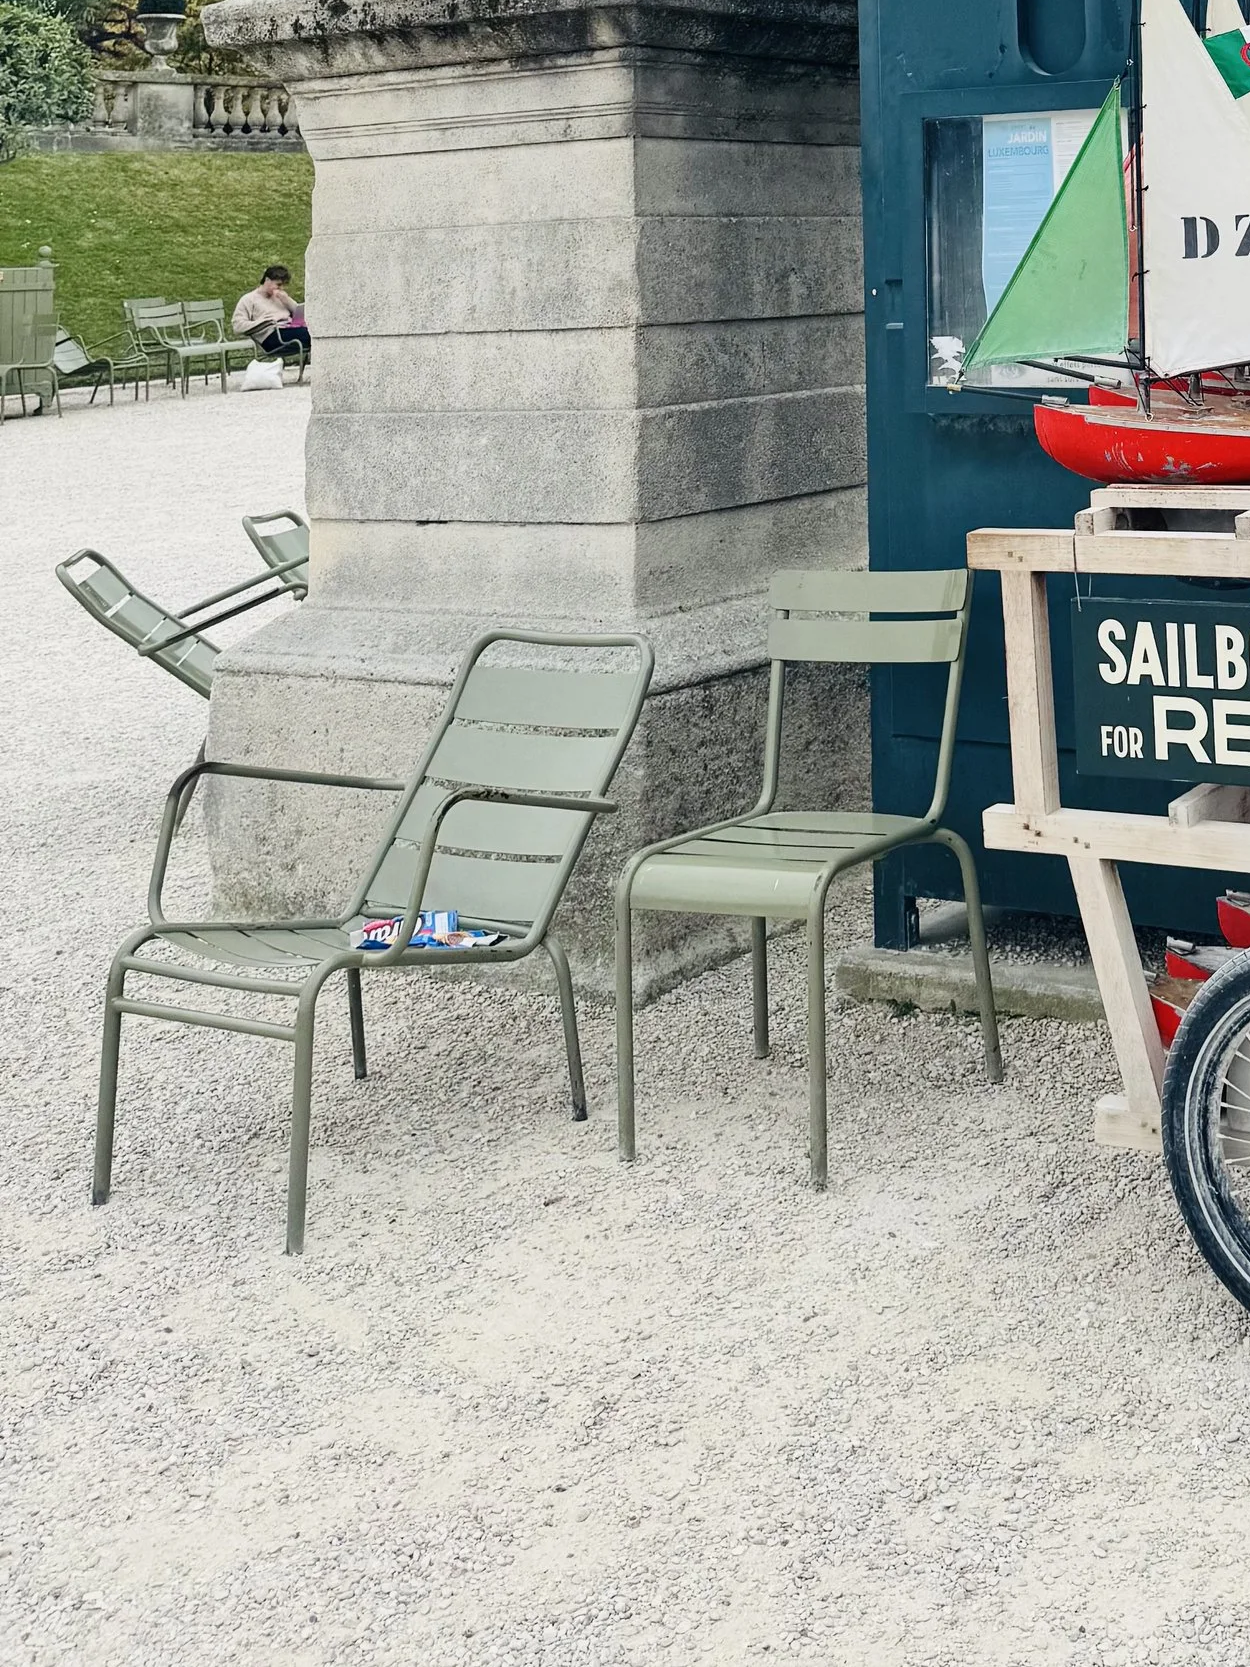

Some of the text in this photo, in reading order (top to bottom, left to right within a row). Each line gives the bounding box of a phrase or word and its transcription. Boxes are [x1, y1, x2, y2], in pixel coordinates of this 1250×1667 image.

[1007, 130, 1047, 144] JARDIN
[987, 144, 1049, 158] LUXEMBOURG
[1100, 725, 1144, 759] FOR
